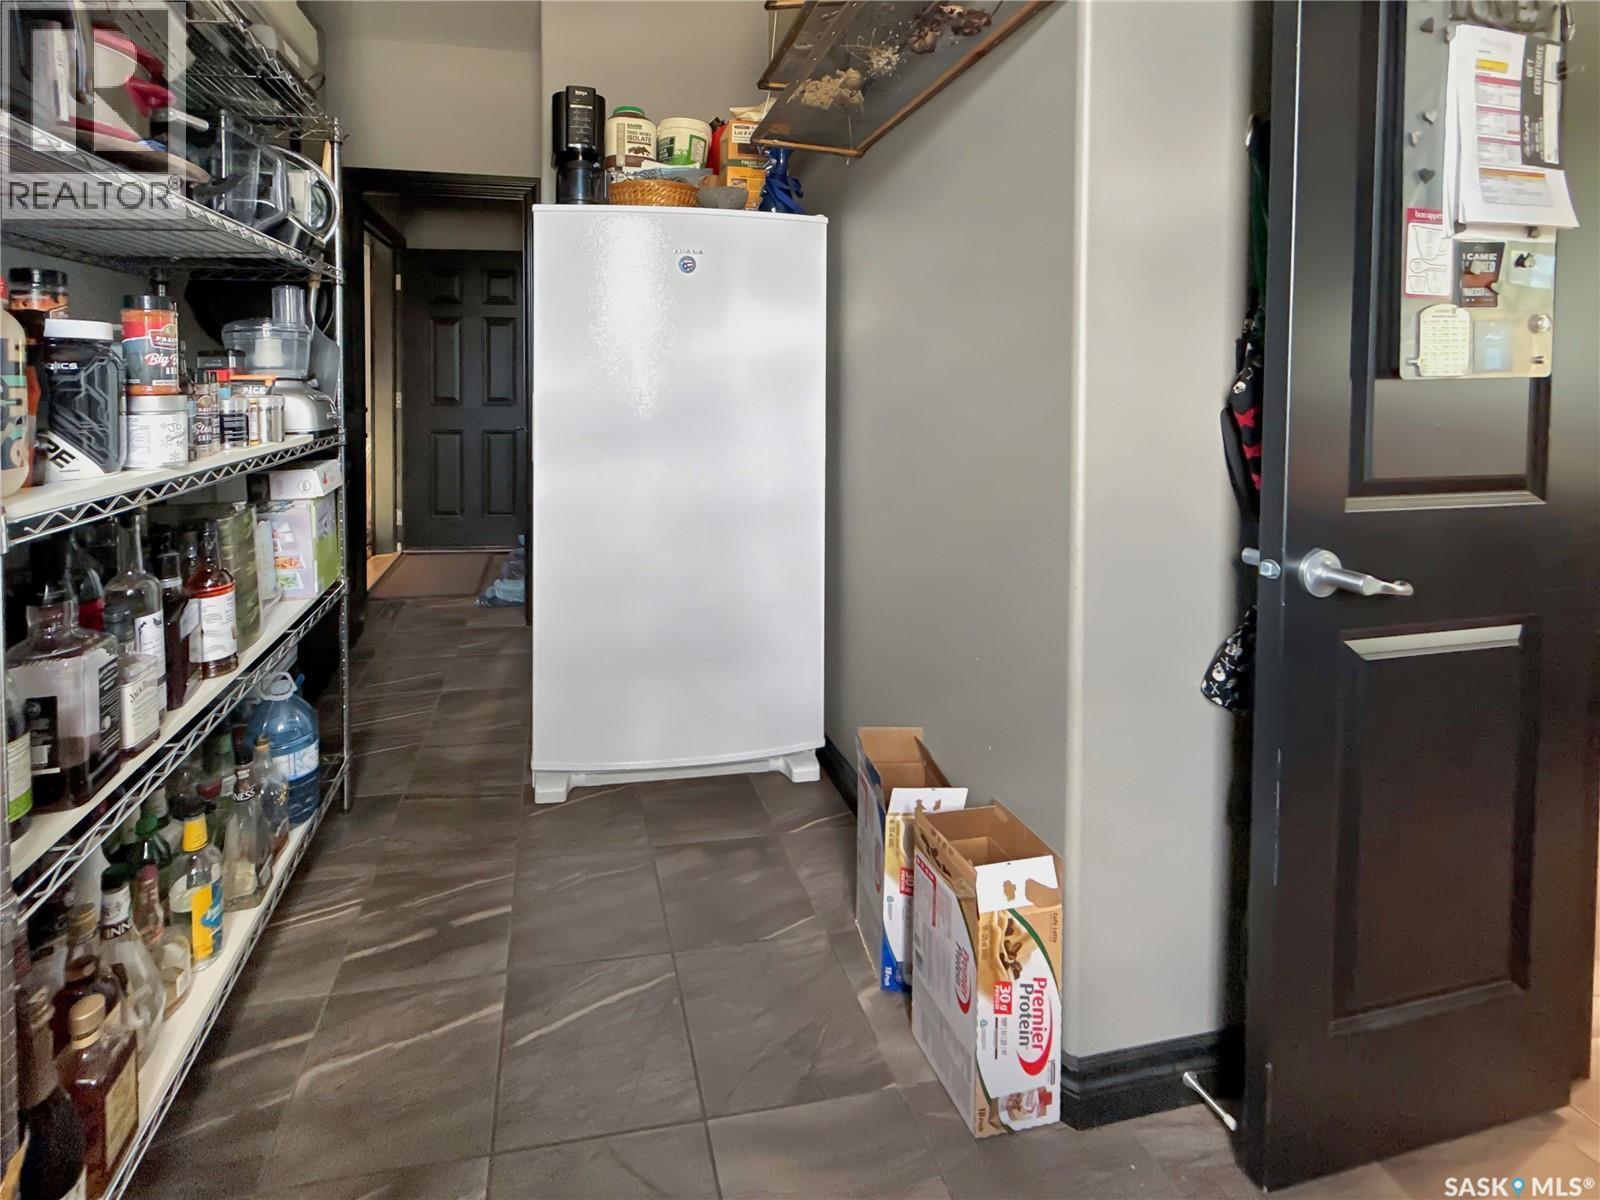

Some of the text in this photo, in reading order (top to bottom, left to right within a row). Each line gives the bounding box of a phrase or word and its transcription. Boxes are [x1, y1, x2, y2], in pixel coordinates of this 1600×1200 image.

[626, 134, 652, 144] ISOLATE
[1018, 983, 1034, 1048] Protein
[1032, 977, 1048, 1051] Premier
